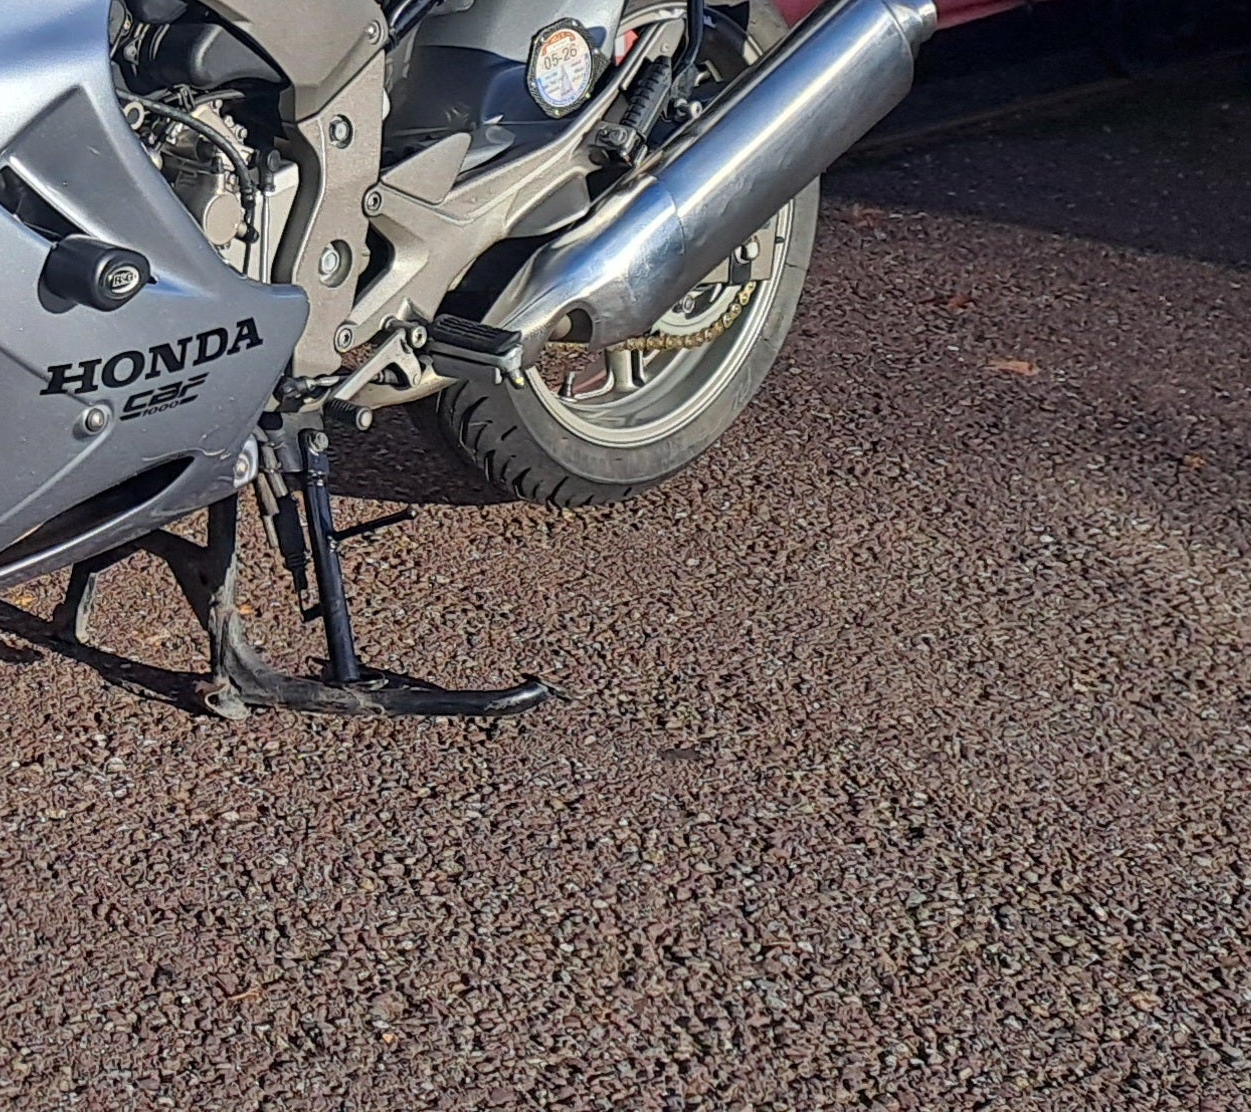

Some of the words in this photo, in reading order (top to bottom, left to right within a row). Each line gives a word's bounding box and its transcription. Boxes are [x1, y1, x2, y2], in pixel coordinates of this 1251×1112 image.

[543, 43, 578, 71] 05-26
[39, 316, 264, 396] HONDA
[141, 399, 181, 418] 1000
